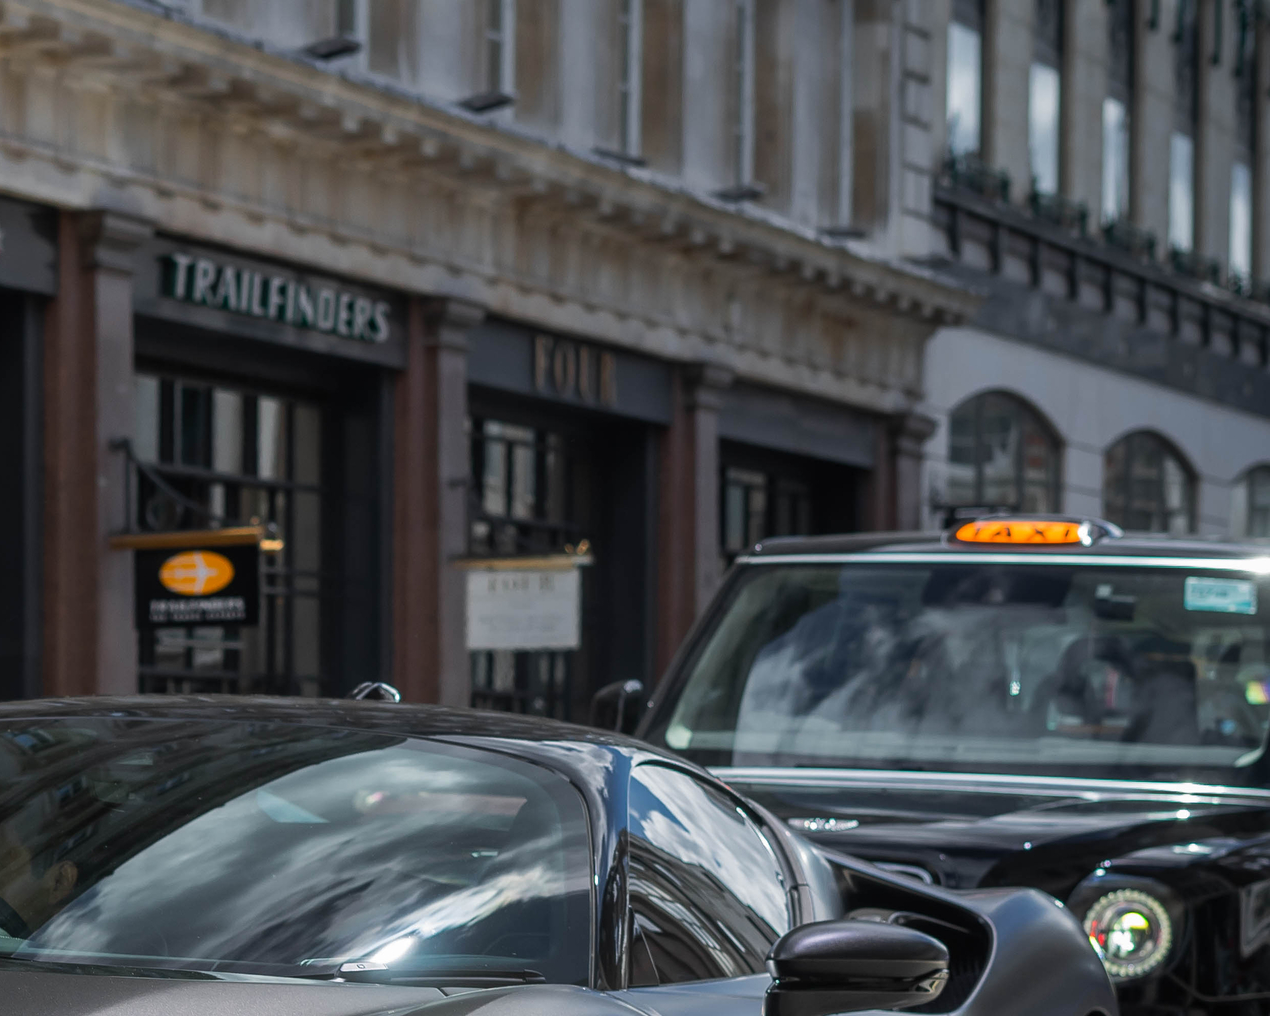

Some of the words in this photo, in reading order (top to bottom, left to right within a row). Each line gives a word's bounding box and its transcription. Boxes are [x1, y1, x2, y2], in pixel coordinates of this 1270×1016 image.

[171, 252, 391, 343] TRAILFINDERS
[534, 335, 617, 407] FOUR
[970, 523, 1072, 543] TAXI
